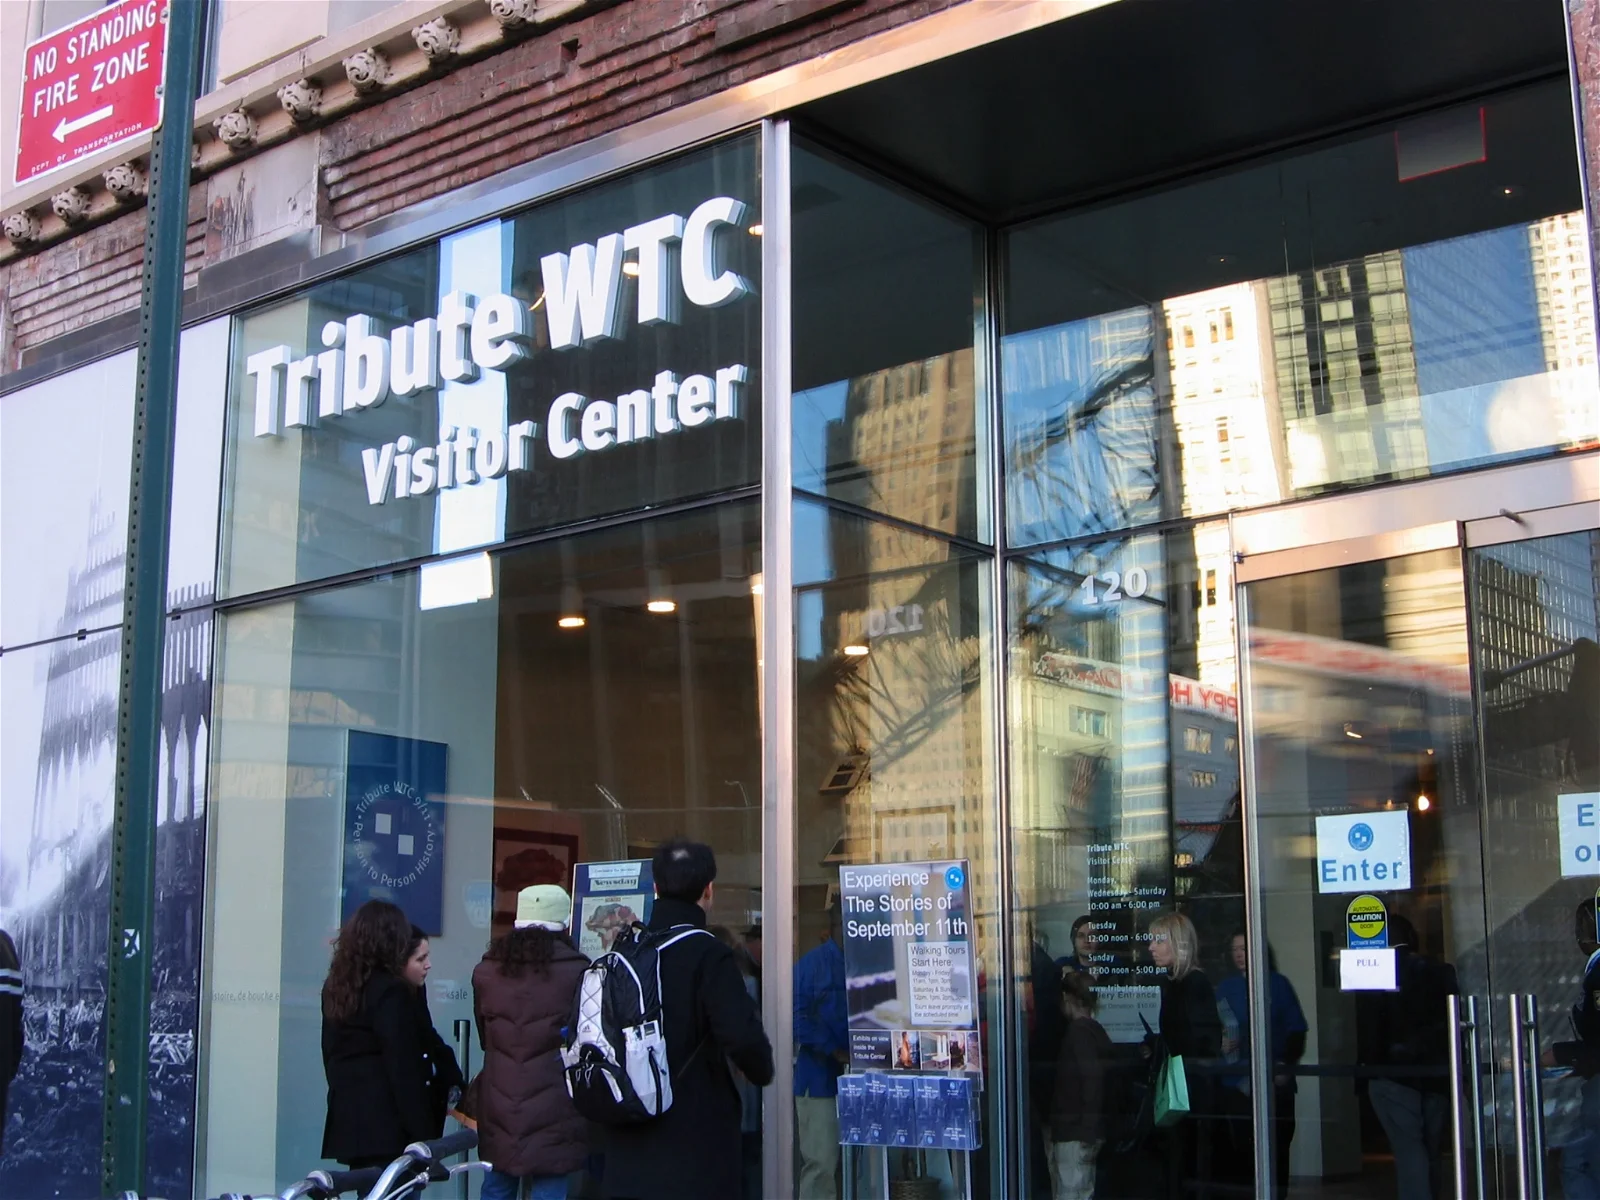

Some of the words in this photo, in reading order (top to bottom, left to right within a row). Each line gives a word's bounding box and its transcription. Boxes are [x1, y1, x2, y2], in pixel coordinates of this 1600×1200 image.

[33, 46, 57, 80] NO
[66, 1, 157, 64] STANDING
[33, 74, 80, 117] FIRE
[91, 42, 150, 92] ZONE
[31, 161, 49, 174] DEPT
[56, 154, 67, 163] OF
[74, 122, 142, 155] TRANSPORTATION
[246, 289, 531, 438] Tribute
[541, 196, 750, 350] WTC
[361, 418, 537, 505] Visitor
[546, 363, 748, 459] Center
[1080, 567, 1149, 605] 120
[355, 783, 390, 813] Tribute
[393, 781, 415, 799] WTC
[412, 797, 431, 820] 9/11
[1087, 843, 1113, 853] Tribute
[1114, 842, 1130, 851] WTC
[367, 866, 378, 880] to
[380, 872, 416, 887] Person
[414, 830, 436, 875] History
[1087, 857, 1110, 866] Visitor
[1322, 859, 1403, 883] Enter
[844, 870, 930, 891] Experience
[1087, 876, 1117, 885] Monday,
[1134, 887, 1167, 896] Saturday
[845, 896, 874, 913] The
[879, 894, 932, 912] Stories
[937, 892, 953, 910] of
[1088, 902, 1109, 910] 10:00
[1128, 901, 1147, 909] 6:00
[1148, 901, 1160, 909] pm
[1351, 914, 1382, 922] CAUTION
[847, 919, 930, 941] September
[935, 917, 968, 935] 11th
[1088, 921, 1117, 930] Tuesday
[1088, 934, 1109, 942] 12:00
[1135, 933, 1154, 941] 6:00
[1155, 934, 1168, 942] pm
[911, 946, 942, 956] Walking
[944, 946, 966, 955] Tours
[912, 958, 930, 967] Start
[1088, 953, 1115, 963] Sunday
[1356, 959, 1380, 967] PULL
[1088, 966, 1110, 975] 12:00
[1136, 965, 1154, 974] 5:00
[1155, 967, 1168, 975] pm
[1118, 991, 1157, 999] Entrance
